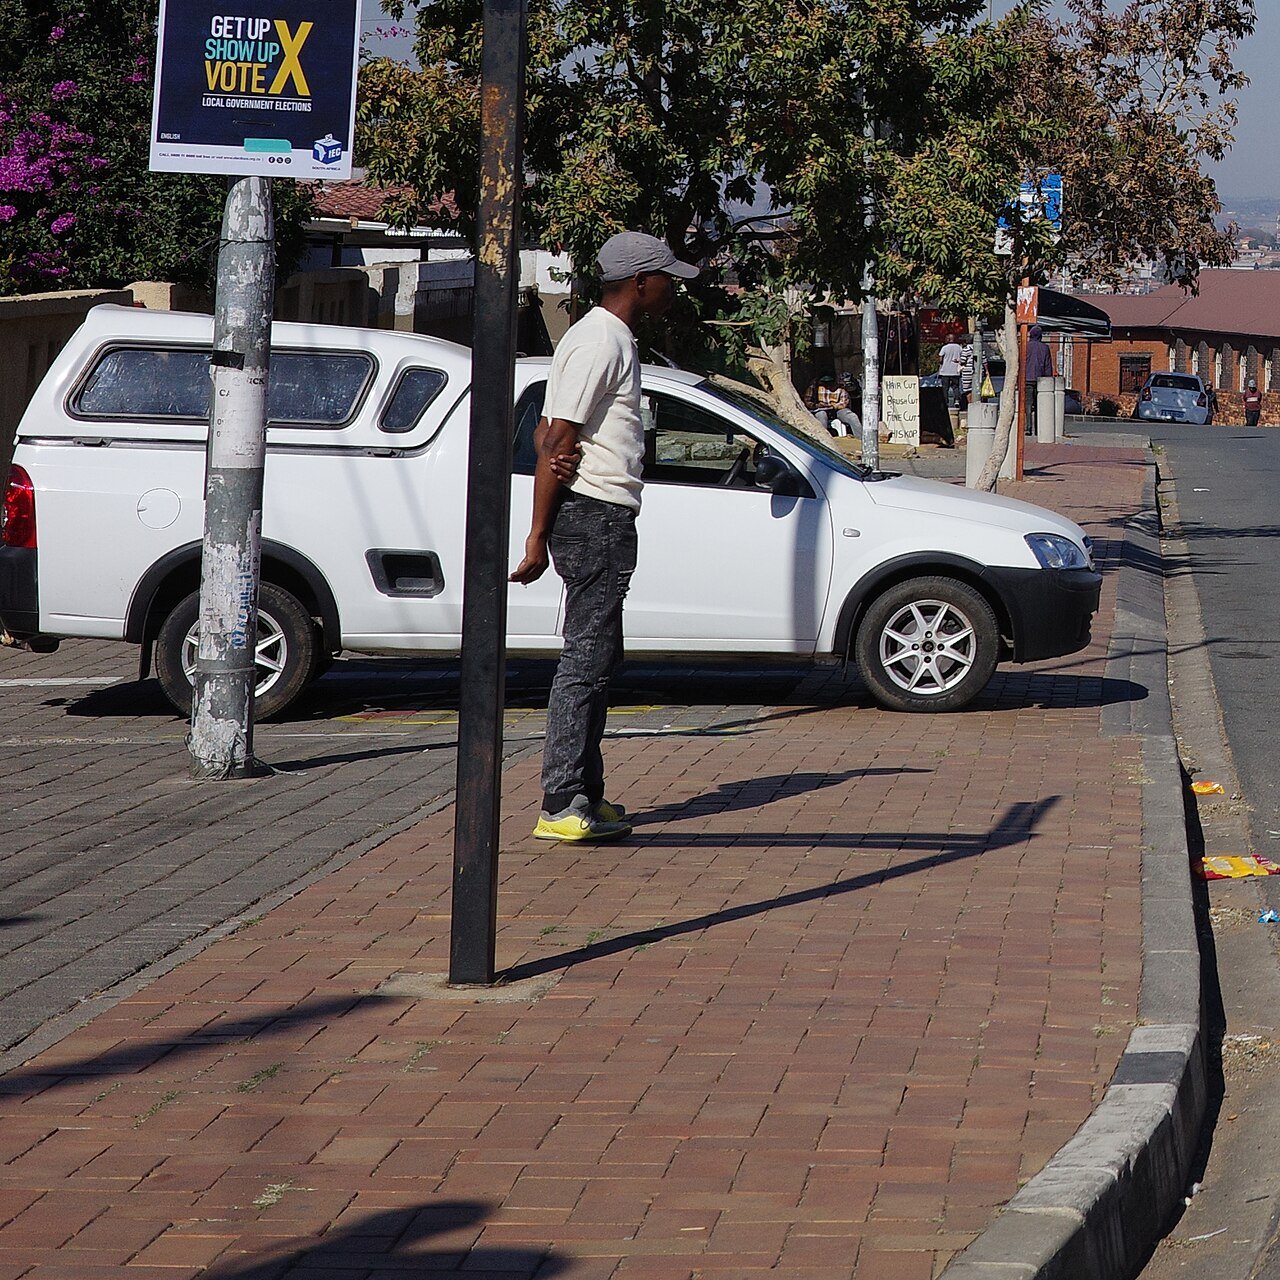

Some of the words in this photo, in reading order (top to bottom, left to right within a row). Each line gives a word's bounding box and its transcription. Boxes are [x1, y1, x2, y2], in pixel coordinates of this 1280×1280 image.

[204, 38, 254, 61] SHOW
[257, 42, 280, 63] UP
[211, 15, 246, 39] GET
[247, 18, 271, 40] UP
[268, 19, 314, 97] X
[204, 60, 267, 94] VOTE
[202, 97, 224, 108] LOCAL
[225, 99, 274, 111] GOVERNMENT
[275, 101, 312, 112] ELECTIONS
[160, 132, 181, 140] ENGLISH
[327, 147, 342, 159] IEC
[885, 381, 902, 390] HAIR
[903, 380, 916, 390] CUT
[886, 395, 908, 406] BRUSH
[907, 394, 919, 405] CUT
[886, 411, 902, 422] FINE
[902, 411, 917, 422] CUT
[891, 430, 918, 439] HISKOP
